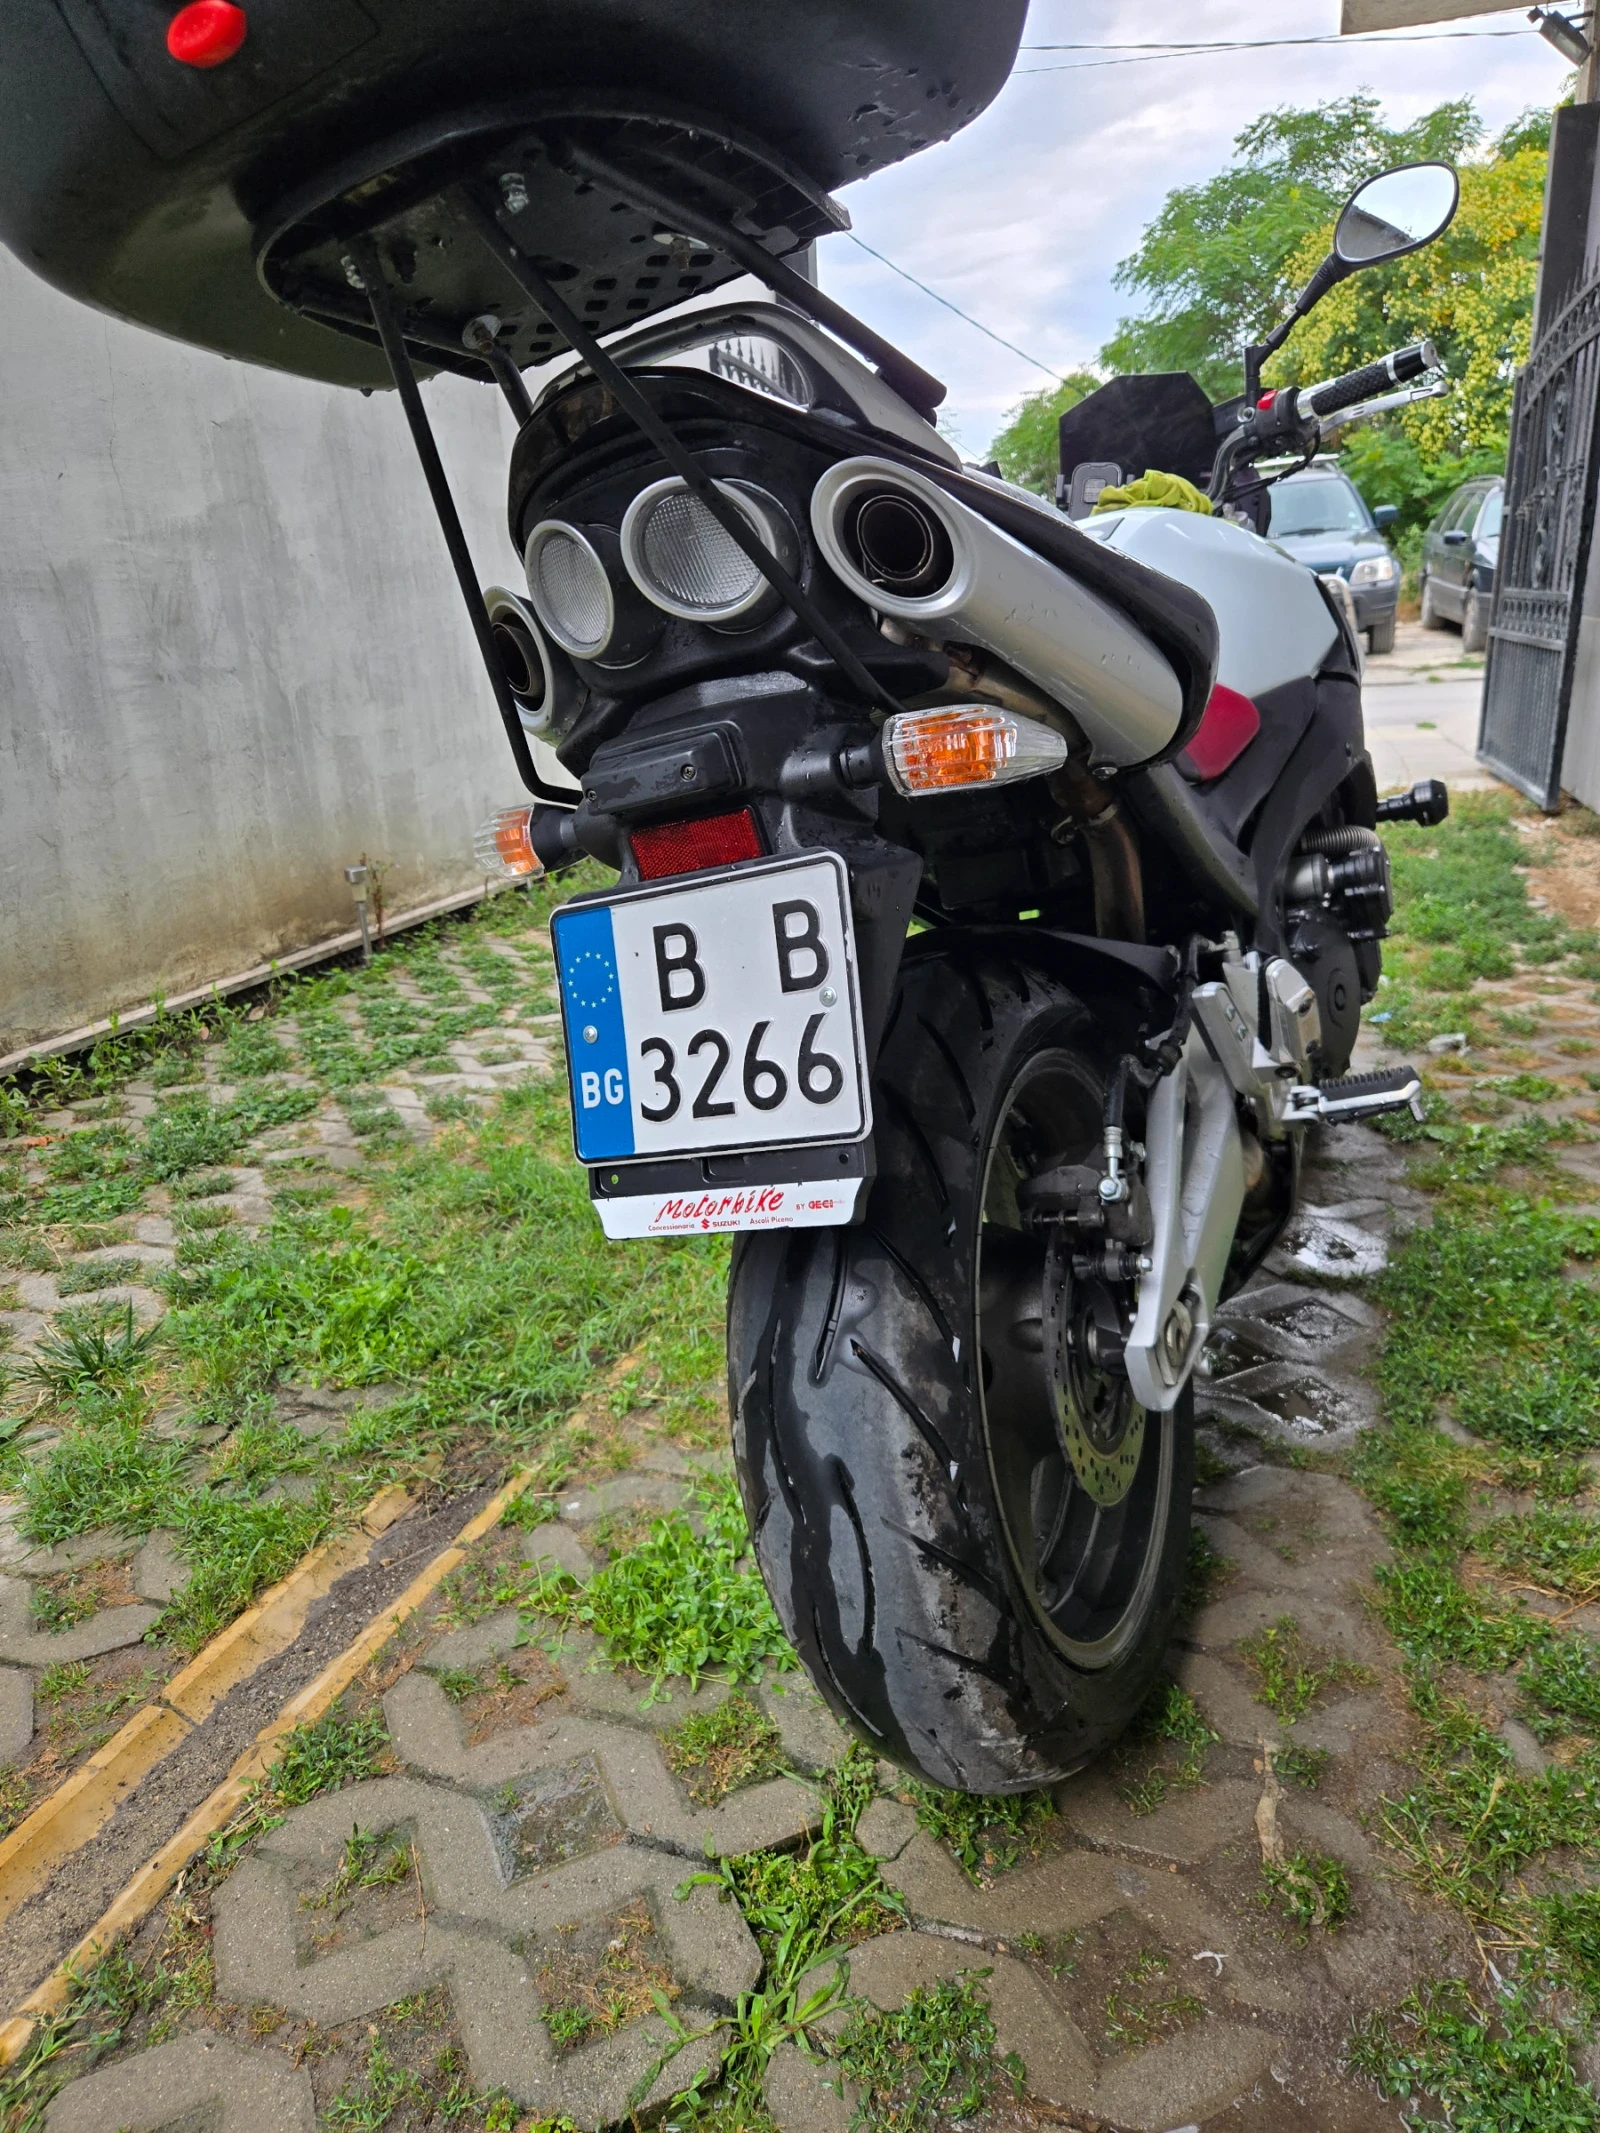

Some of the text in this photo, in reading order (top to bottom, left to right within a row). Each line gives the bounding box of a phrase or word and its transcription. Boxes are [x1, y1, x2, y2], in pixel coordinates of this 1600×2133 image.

[652, 899, 831, 1012] B B
[580, 1067, 625, 1109] BG
[640, 1012, 844, 1123] 3266
[655, 1187, 785, 1222] Motorbike
[712, 1220, 741, 1228] SUZUKI
[749, 1217, 770, 1225] Ascoli
[771, 1216, 794, 1224] Piceno
